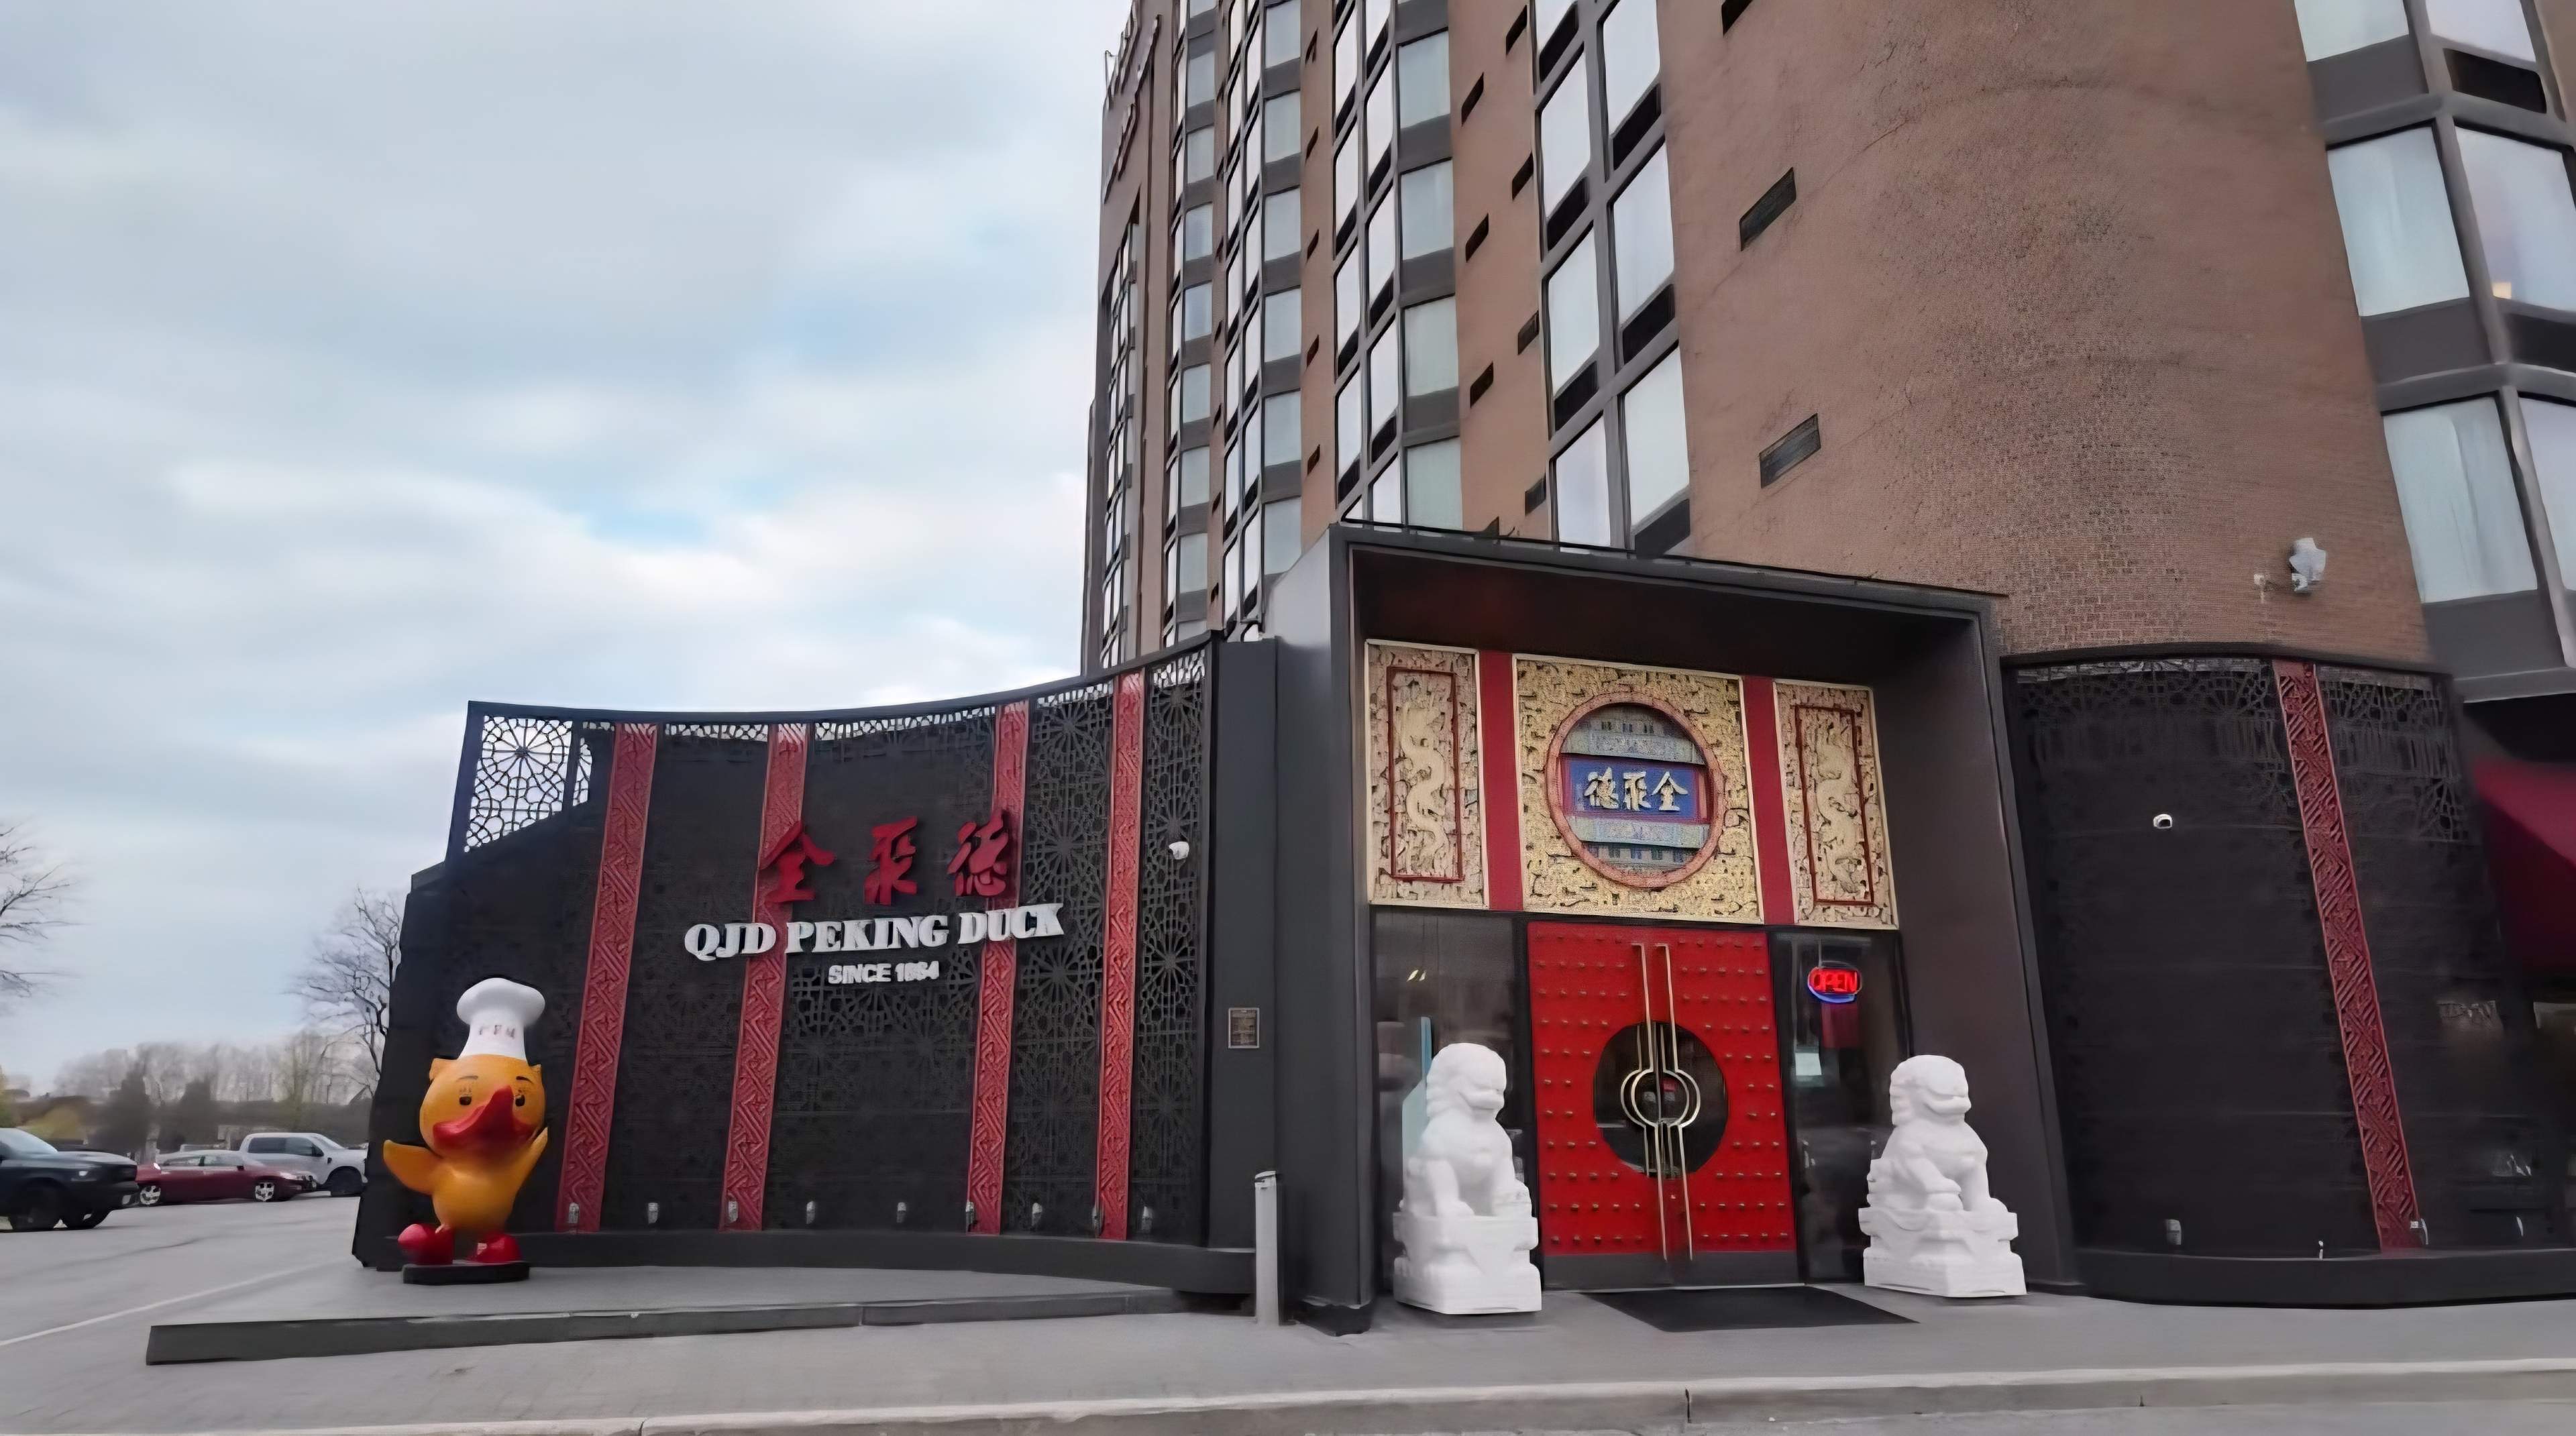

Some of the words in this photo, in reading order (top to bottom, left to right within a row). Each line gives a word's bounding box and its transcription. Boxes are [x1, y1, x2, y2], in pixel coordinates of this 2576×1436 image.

[684, 922, 777, 961] QJD
[785, 915, 949, 954] PEKING
[957, 903, 1065, 945] DUCK
[828, 962, 892, 984] SINCE
[1809, 970, 1858, 993] OPEN
